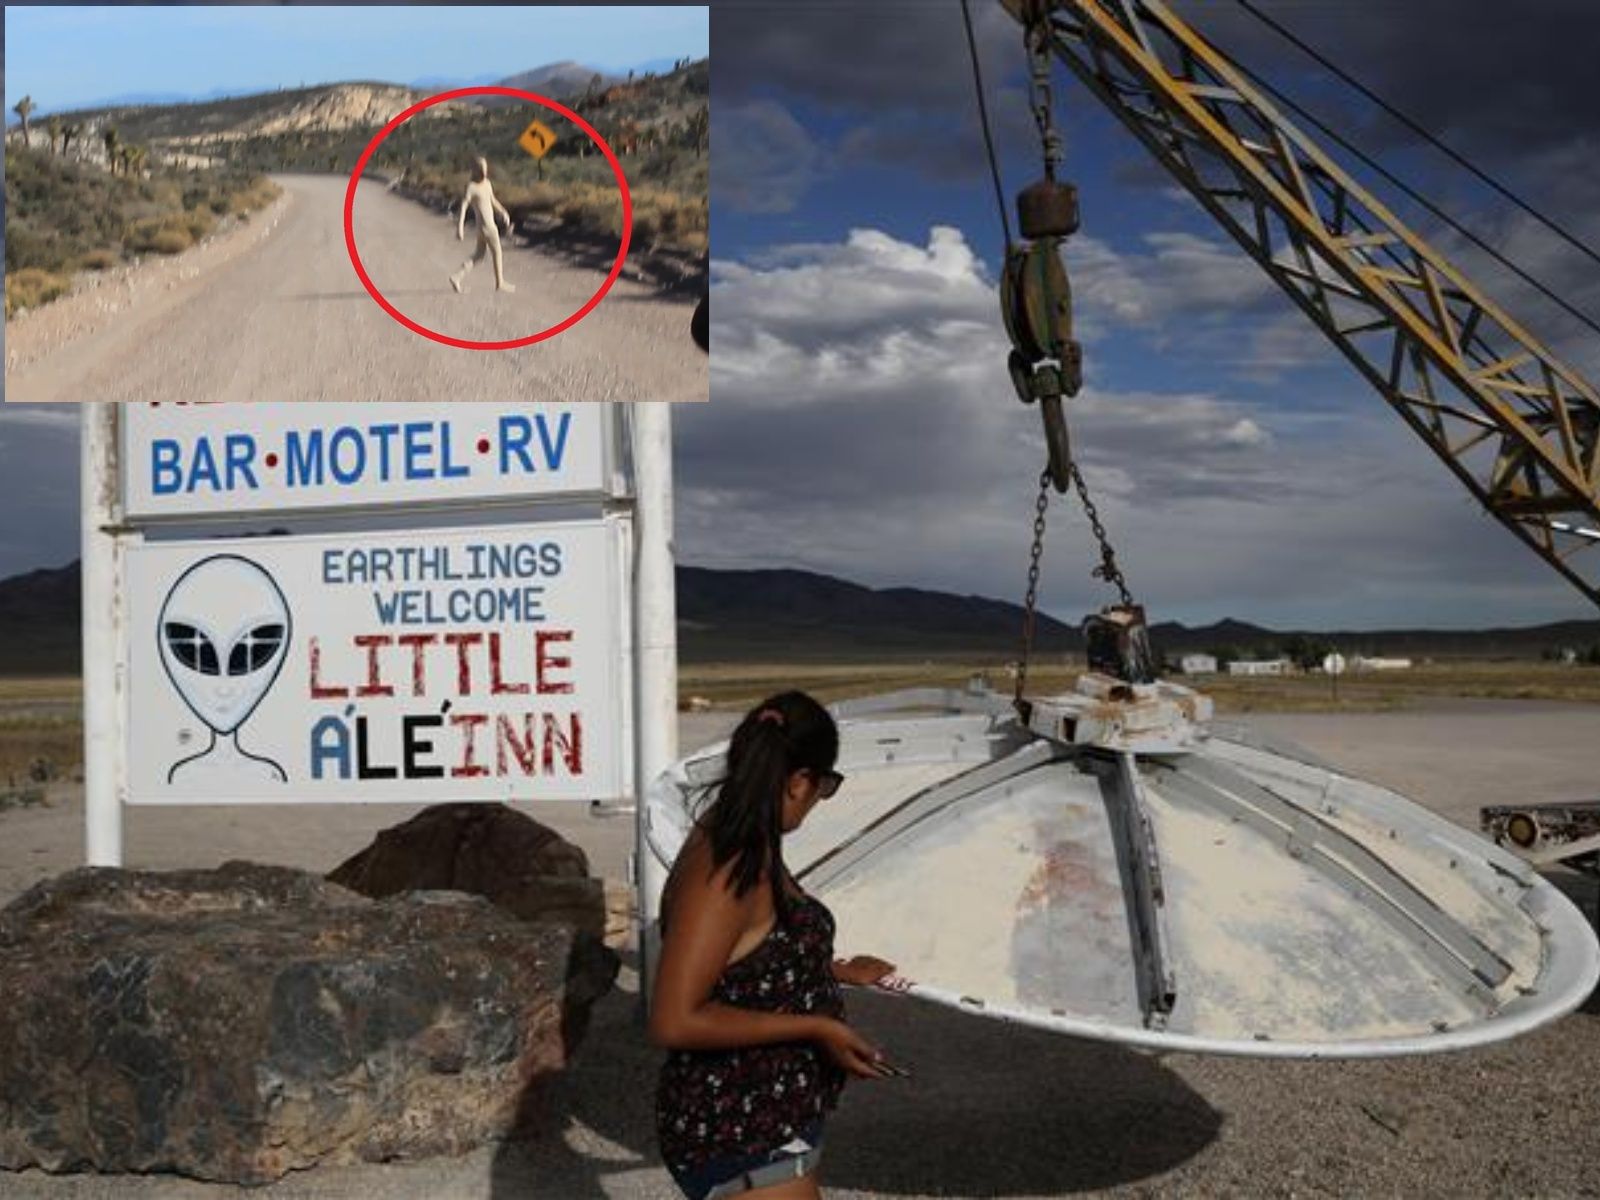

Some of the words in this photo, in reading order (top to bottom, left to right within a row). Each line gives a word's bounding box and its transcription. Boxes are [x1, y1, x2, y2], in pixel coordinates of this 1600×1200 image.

[151, 432, 259, 495] BAR
[285, 421, 470, 487] MOTEL
[498, 412, 572, 473] RV
[322, 543, 563, 584] EARTHLINGS
[374, 587, 546, 625] WELCOME
[309, 630, 574, 699] LITTLE
